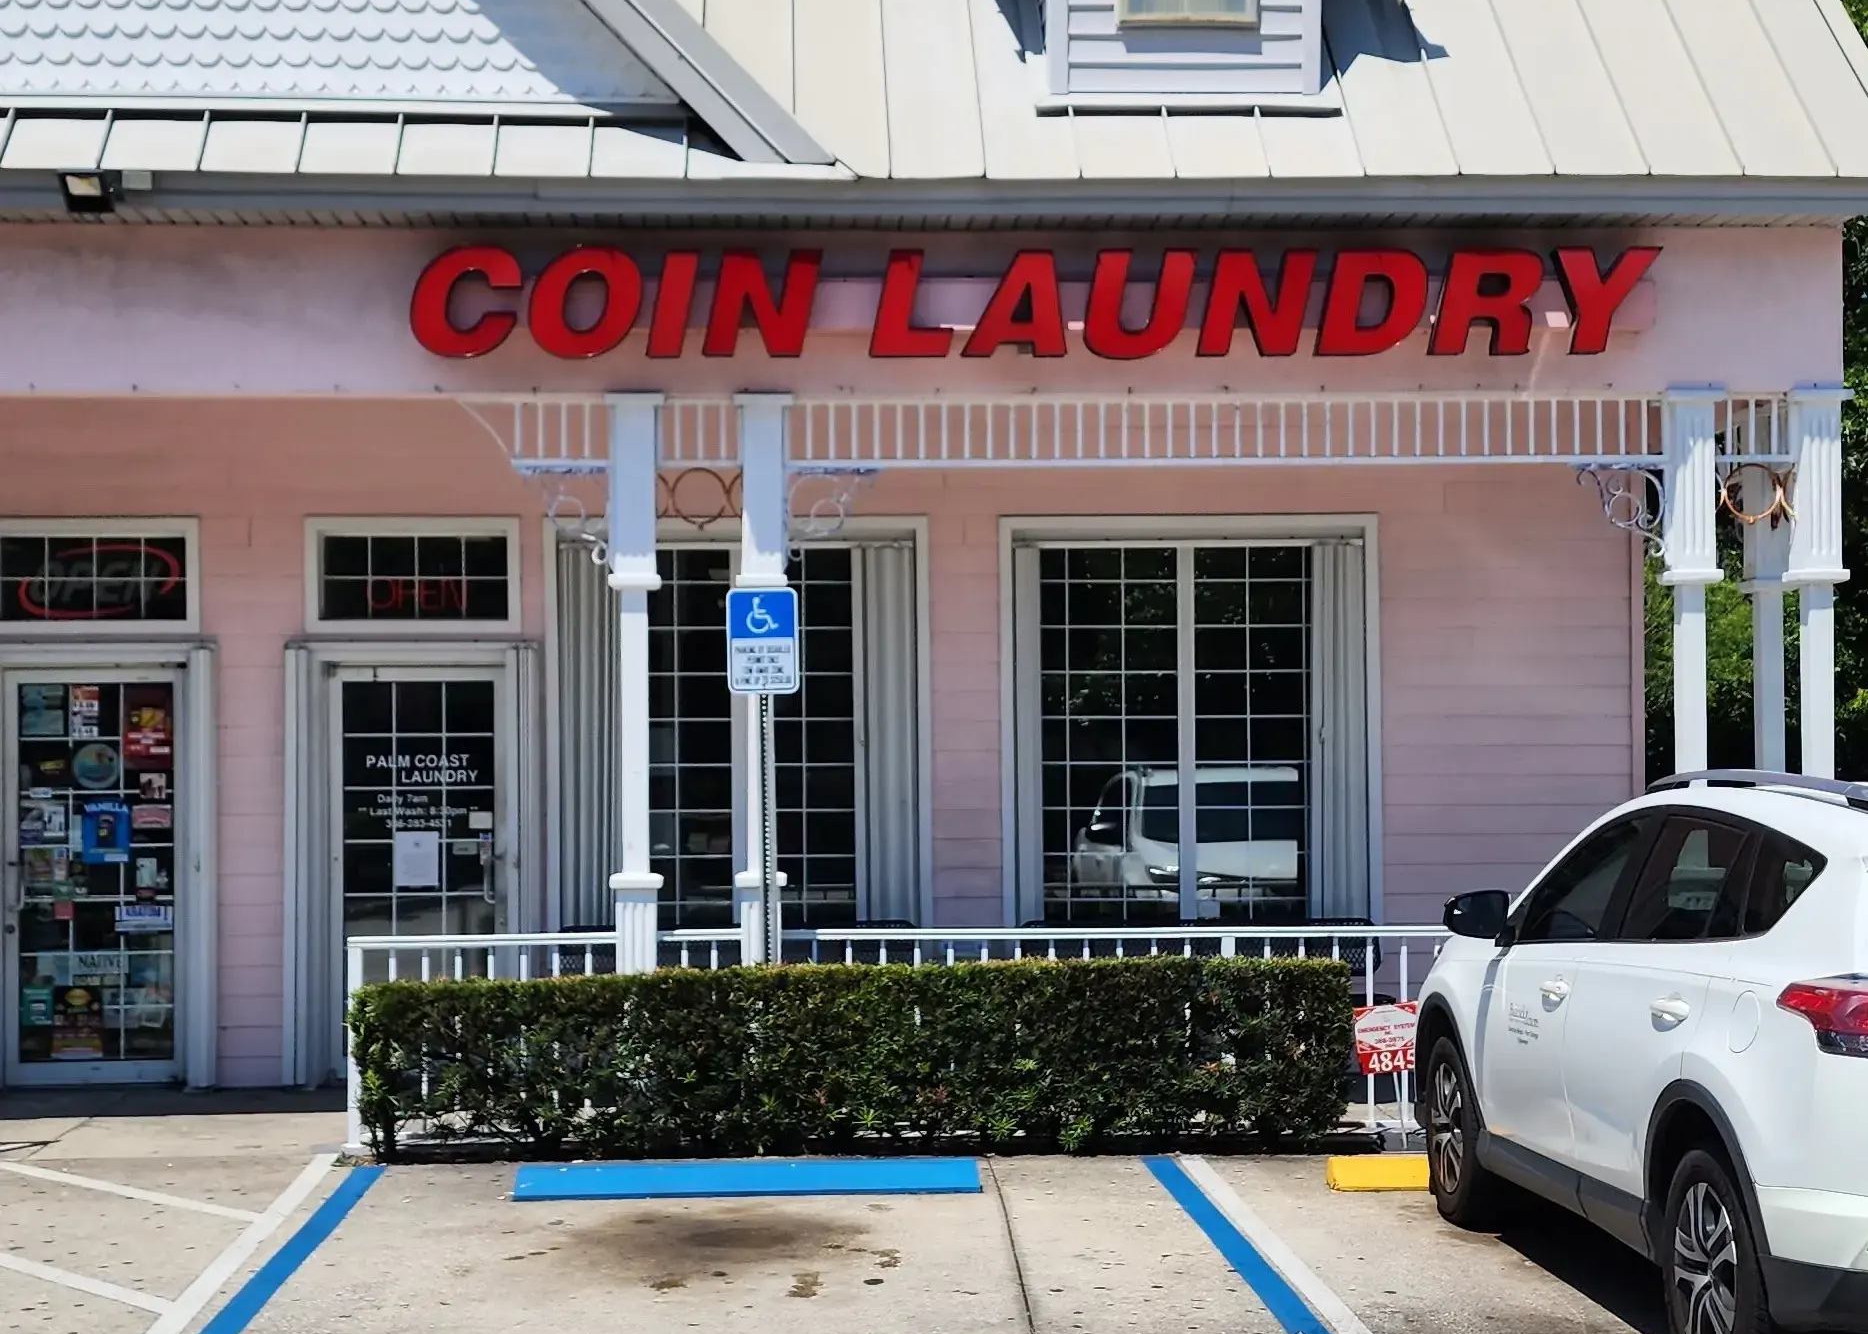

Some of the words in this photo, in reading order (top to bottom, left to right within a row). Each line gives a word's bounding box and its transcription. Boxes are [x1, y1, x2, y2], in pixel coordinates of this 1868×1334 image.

[410, 245, 822, 359] COIN
[868, 246, 1664, 359] LAUNDRY
[29, 560, 164, 603] OPEN
[366, 576, 468, 610] OPEN
[366, 754, 411, 768] PALM
[414, 753, 470, 768] COAST
[401, 769, 478, 783] LAUNDRY
[84, 801, 129, 813] VANILLA
[377, 793, 404, 805] Day
[1368, 1049, 1415, 1072] 4845
